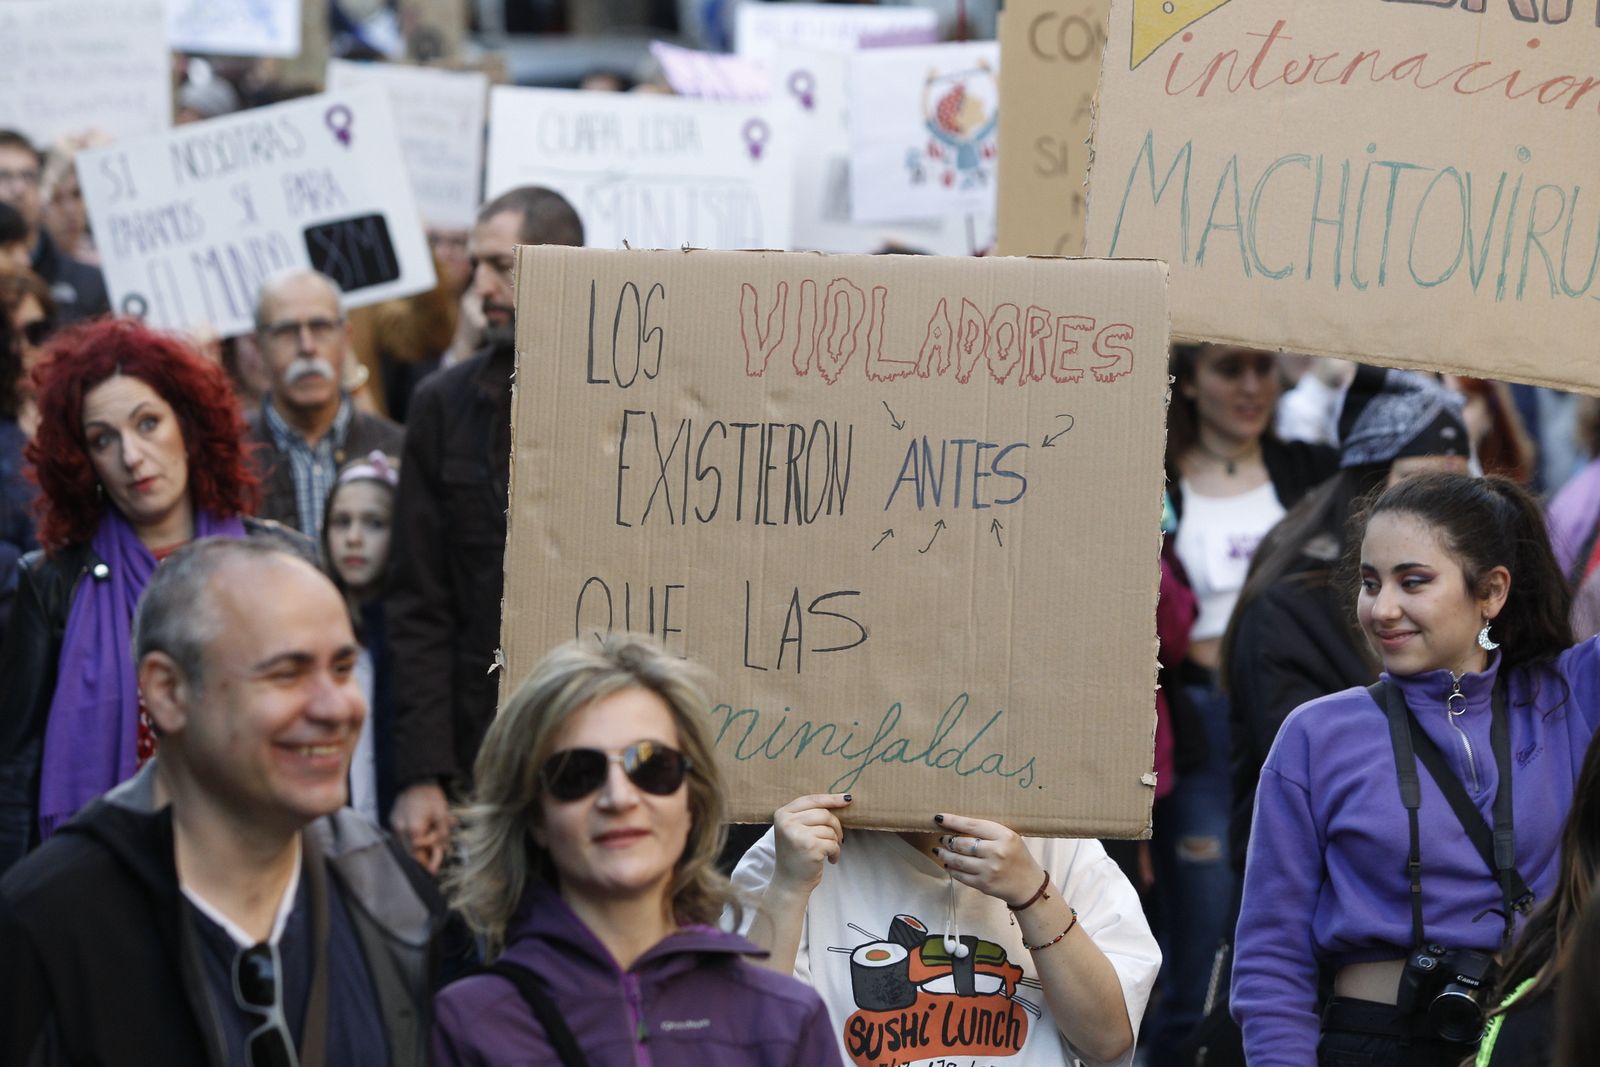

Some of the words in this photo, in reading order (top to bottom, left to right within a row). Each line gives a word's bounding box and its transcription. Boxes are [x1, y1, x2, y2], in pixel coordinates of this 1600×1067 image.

[99, 151, 138, 203] SI
[1110, 129, 1600, 302] MACHITOVIRU
[586, 279, 665, 388] LOS
[739, 277, 1135, 387] VIOLADORES
[615, 409, 853, 528] EXISTIERON
[883, 435, 1030, 511] ANTES
[576, 576, 687, 660] QUE
[743, 579, 869, 674] LAS
[1456, 974, 1480, 987] Canon
